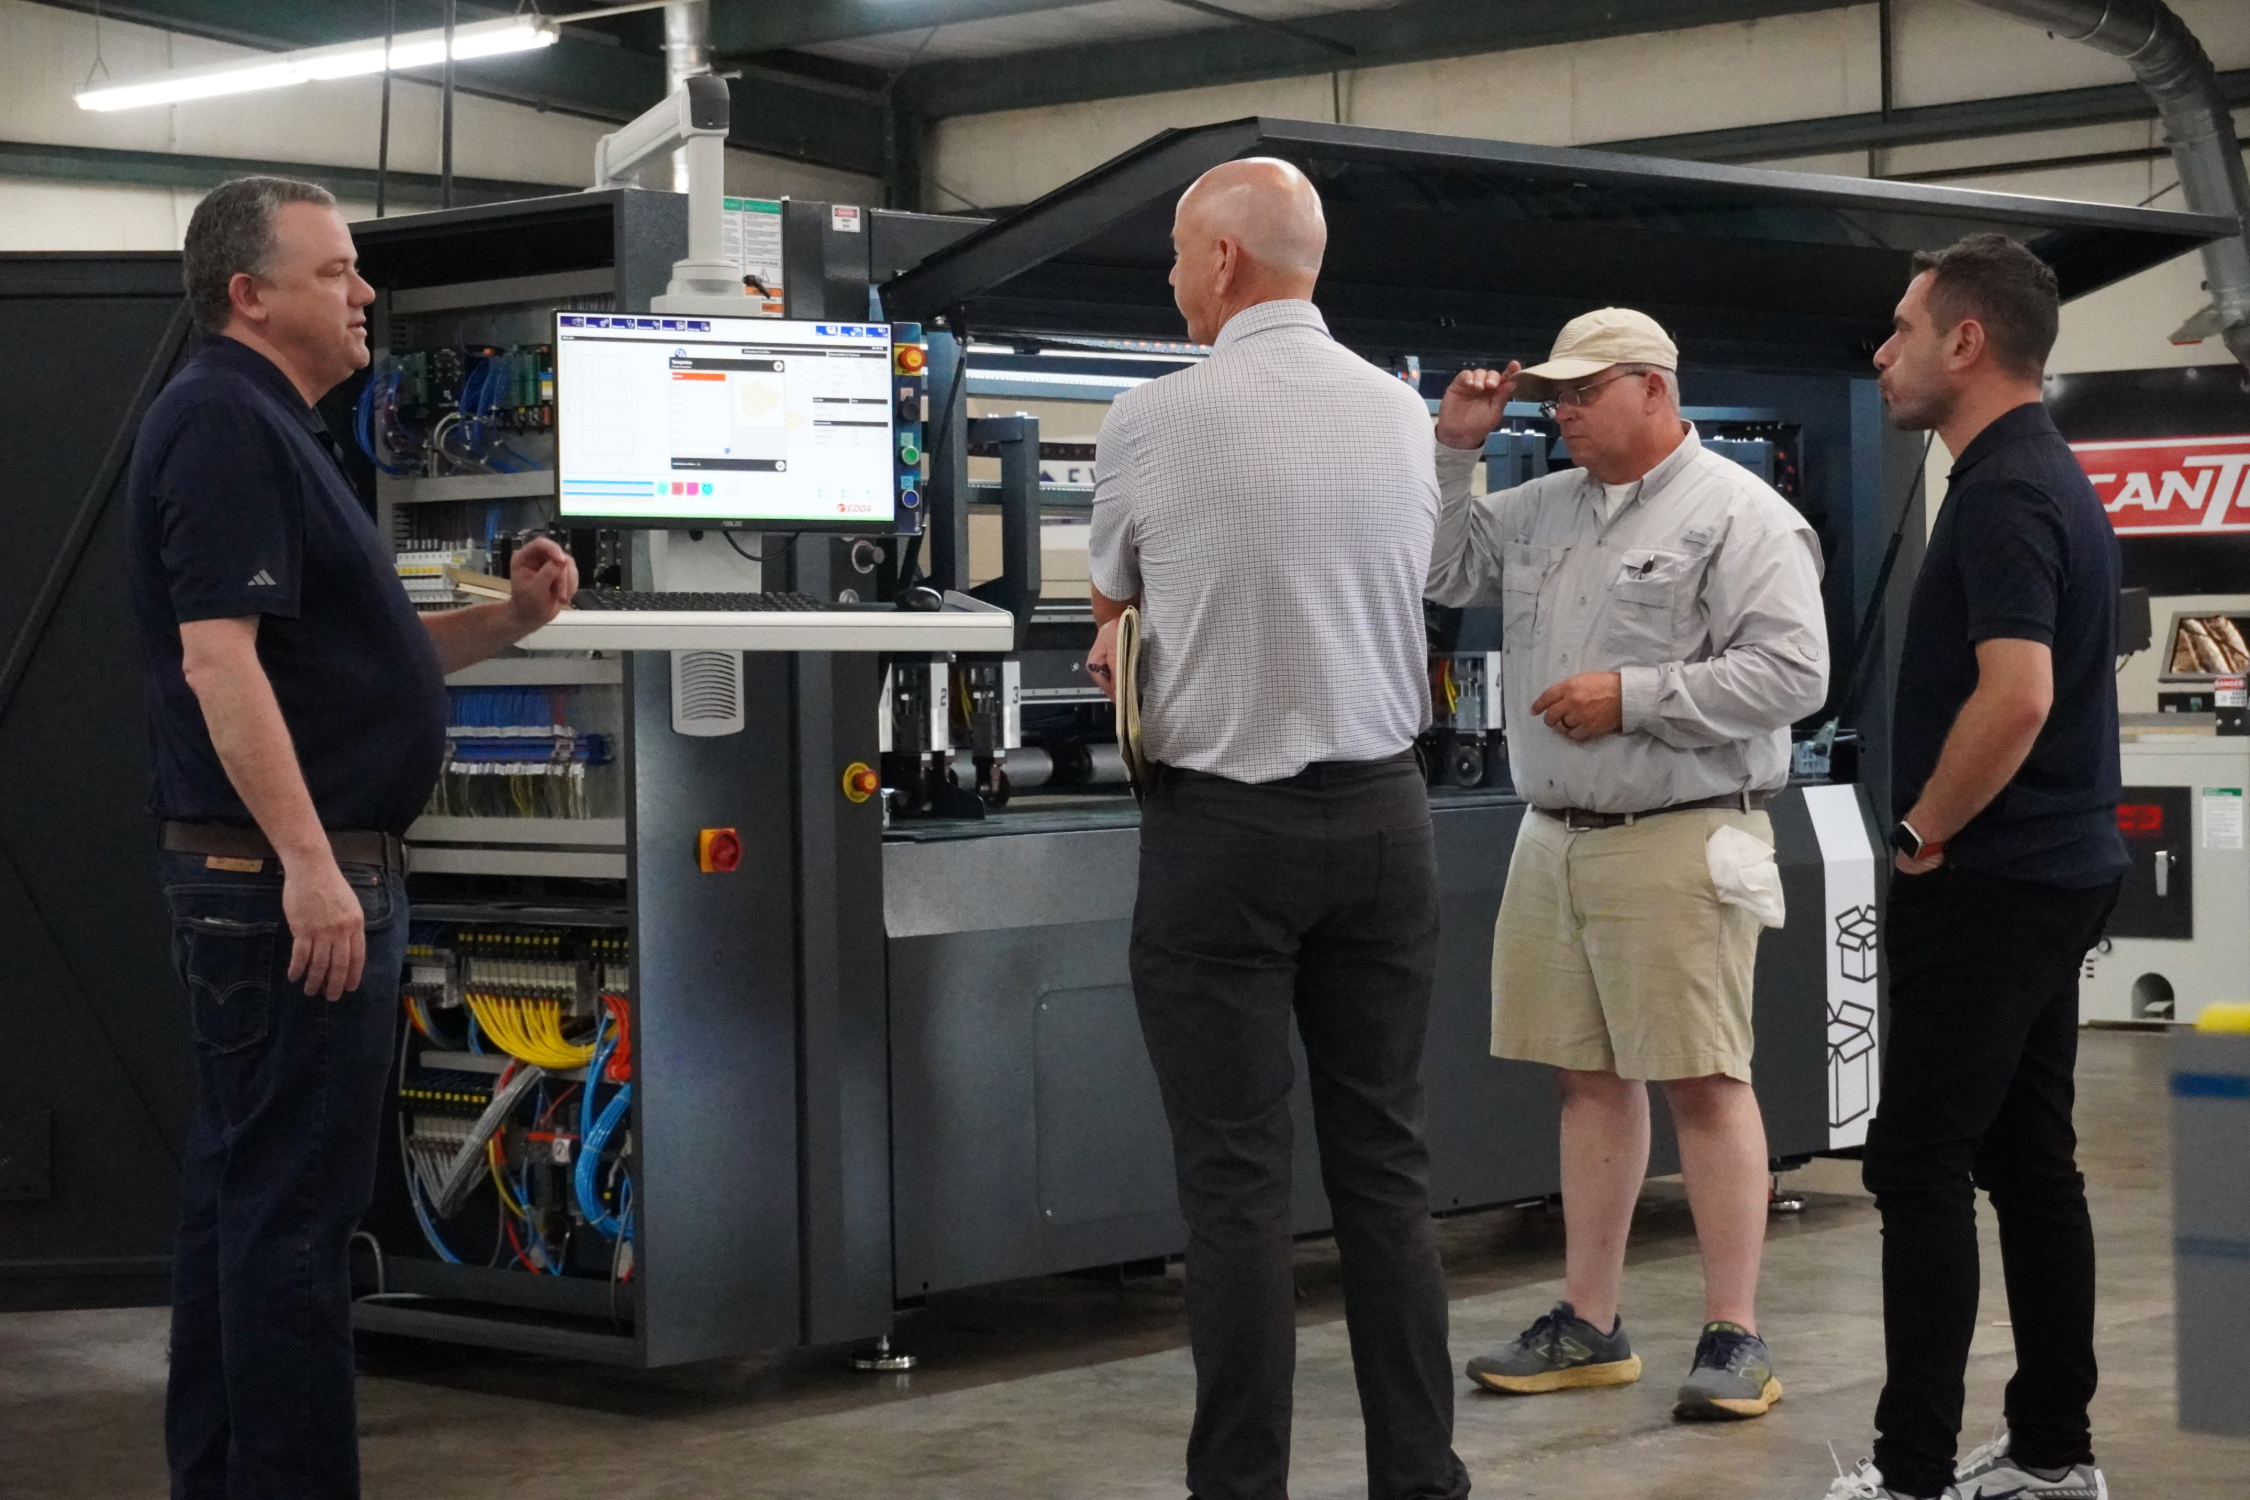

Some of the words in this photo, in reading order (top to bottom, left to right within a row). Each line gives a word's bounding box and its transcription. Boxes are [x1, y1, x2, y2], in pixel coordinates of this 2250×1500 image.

[847, 504, 872, 513] EDDA
[2214, 679, 2244, 688] DANGER
[940, 687, 947, 706] 2
[1012, 686, 1019, 704] 3
